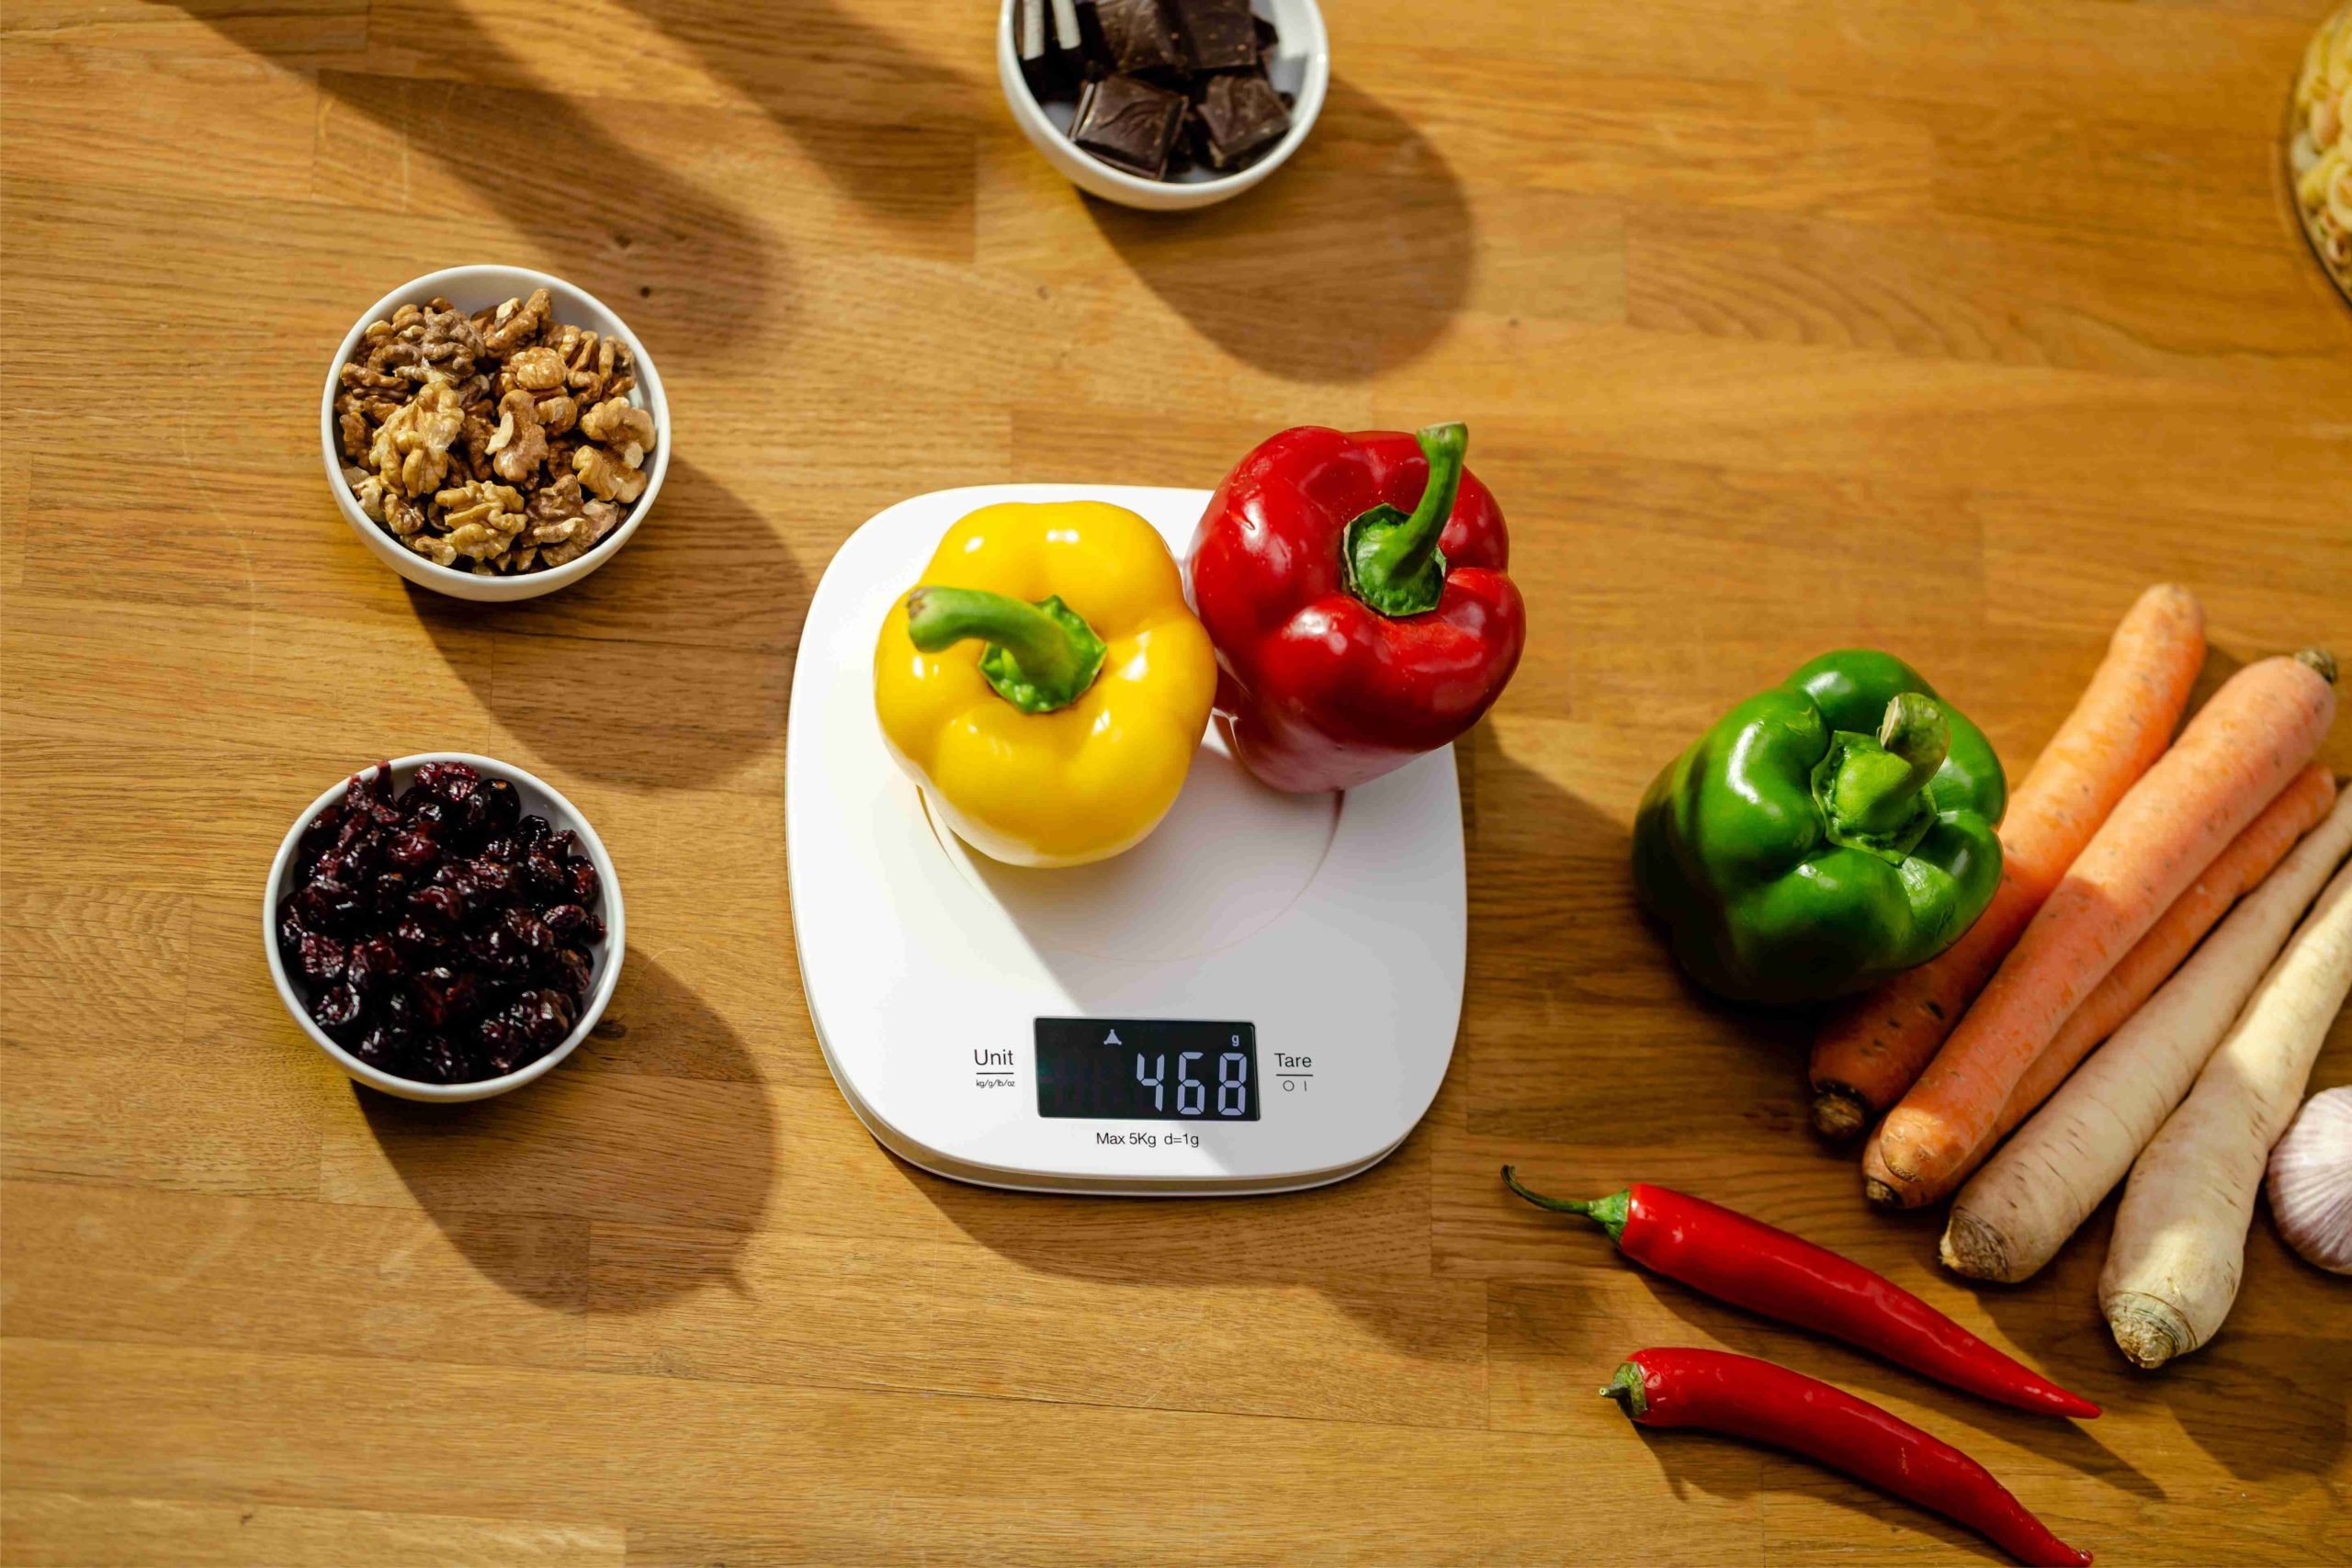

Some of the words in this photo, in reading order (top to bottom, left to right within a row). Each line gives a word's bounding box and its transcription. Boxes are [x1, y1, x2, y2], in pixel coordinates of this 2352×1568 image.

[1231, 1033, 1239, 1047] g
[974, 1048, 1014, 1066] Unit
[1273, 1053, 1312, 1067] Tare
[1136, 1051, 1248, 1116] 468
[1096, 1132, 1125, 1145] Max
[1129, 1132, 1157, 1148] 5Kg
[1164, 1133, 1199, 1148] d=1g
